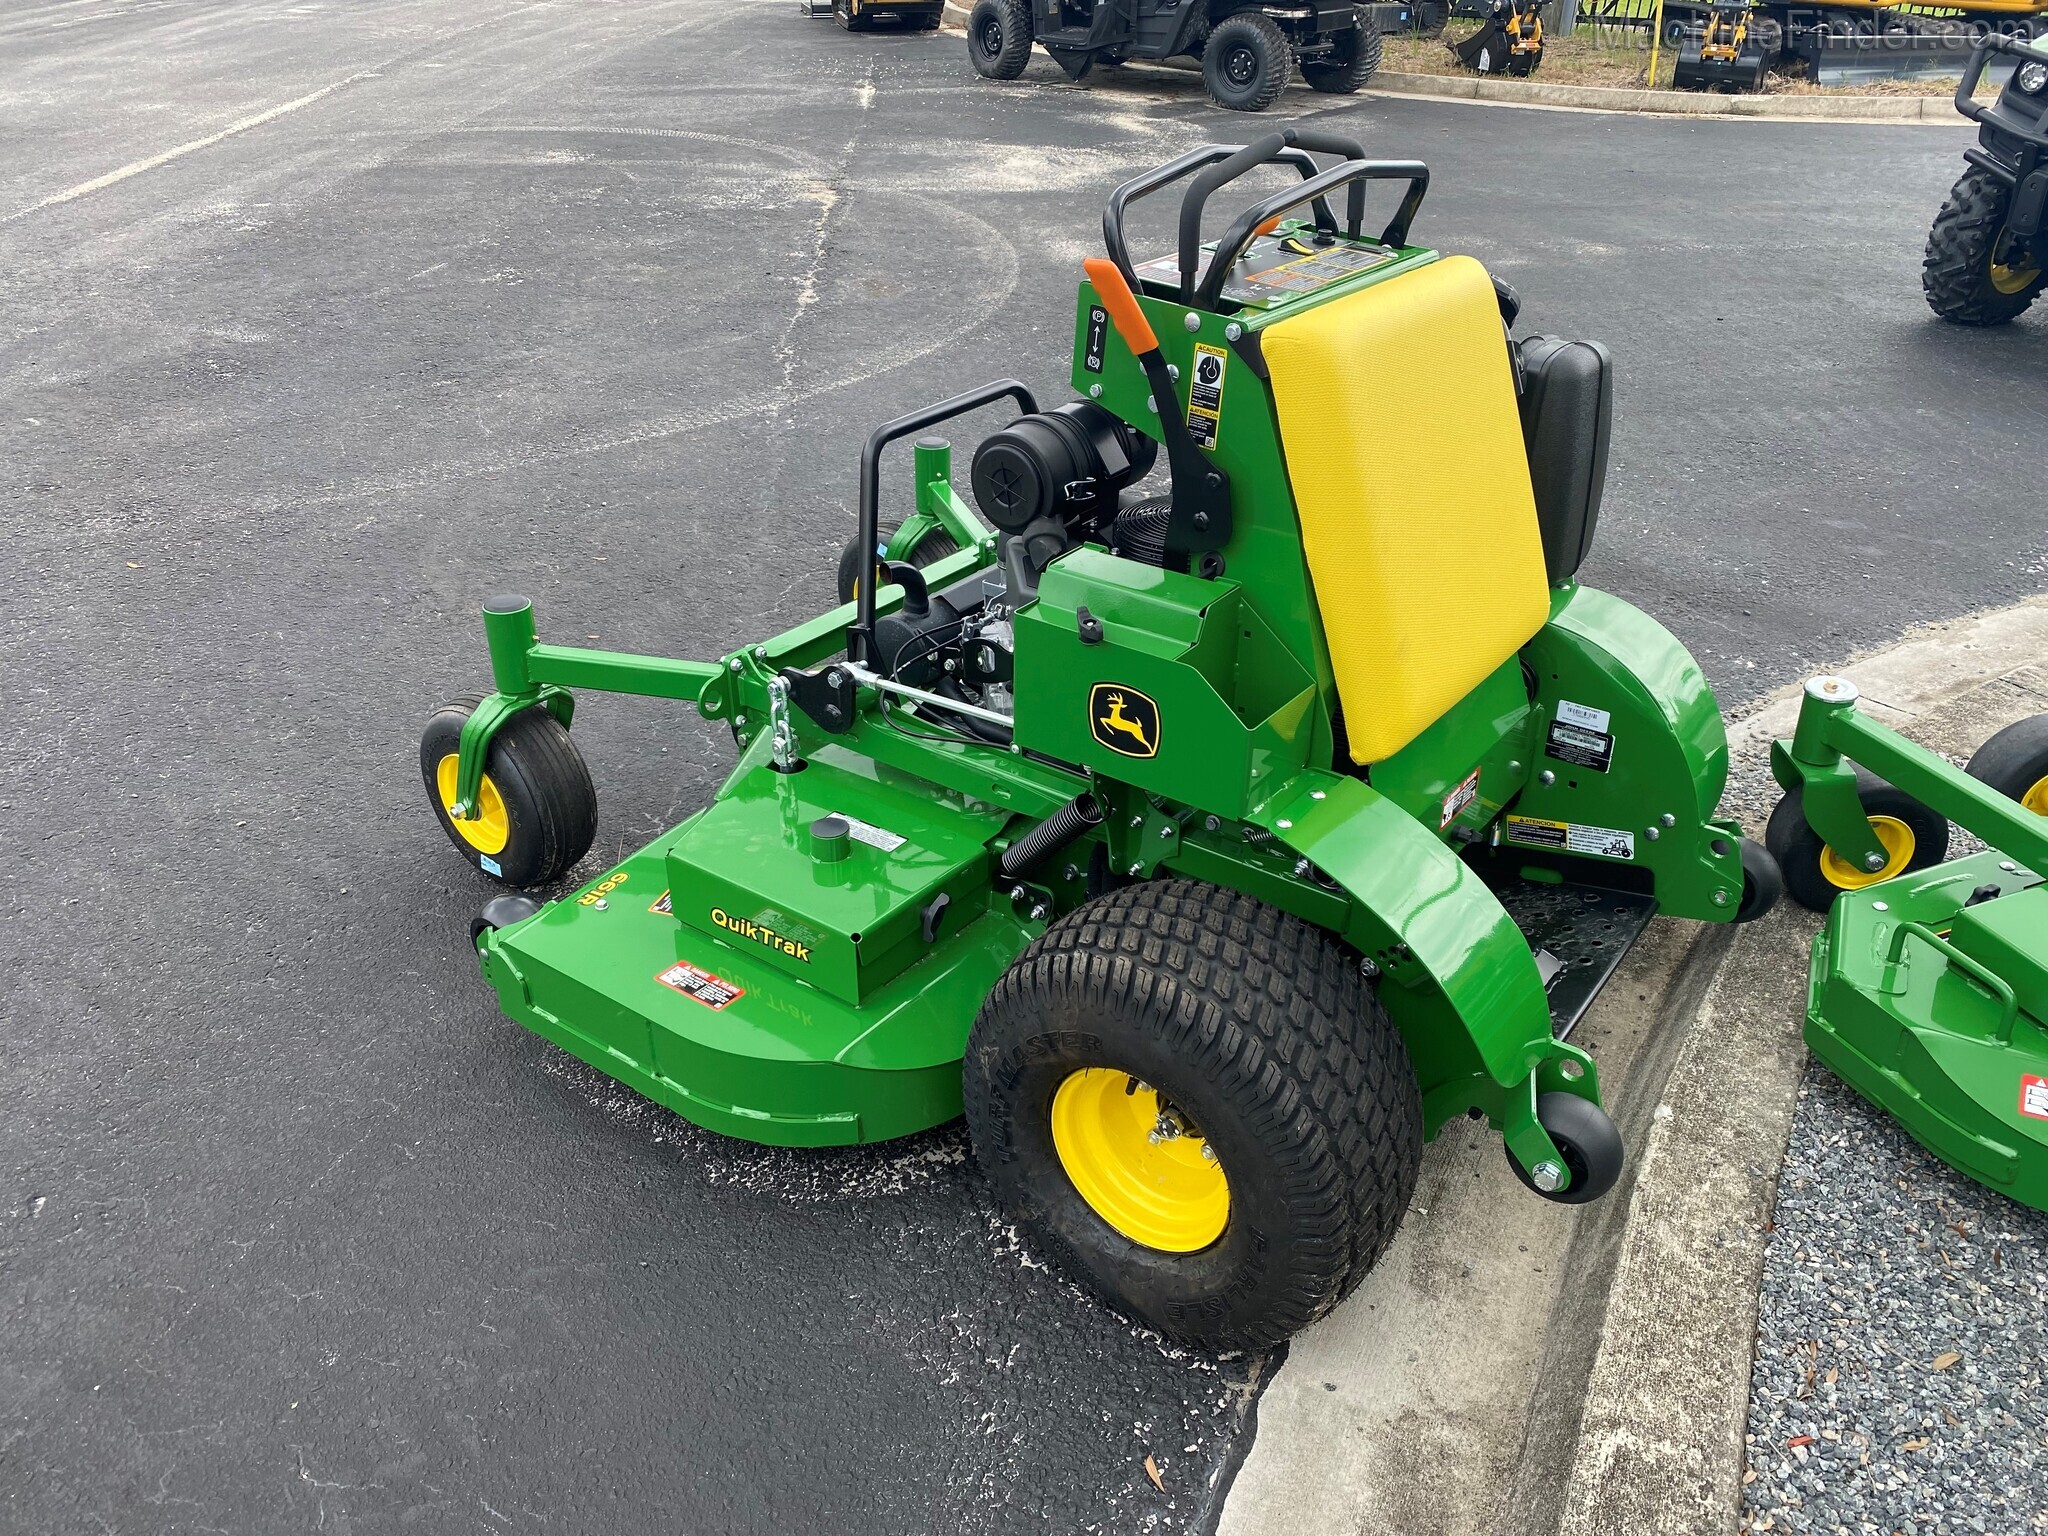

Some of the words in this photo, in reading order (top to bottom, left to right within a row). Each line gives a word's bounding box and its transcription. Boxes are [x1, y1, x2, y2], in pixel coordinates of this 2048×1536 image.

[1202, 345, 1226, 355] CAUTION
[575, 872, 630, 906] 661R
[711, 907, 814, 964] QuikTrak
[690, 966, 711, 979] DANGER
[719, 979, 740, 993] PELIGRO
[996, 1030, 1104, 1089] MASTER
